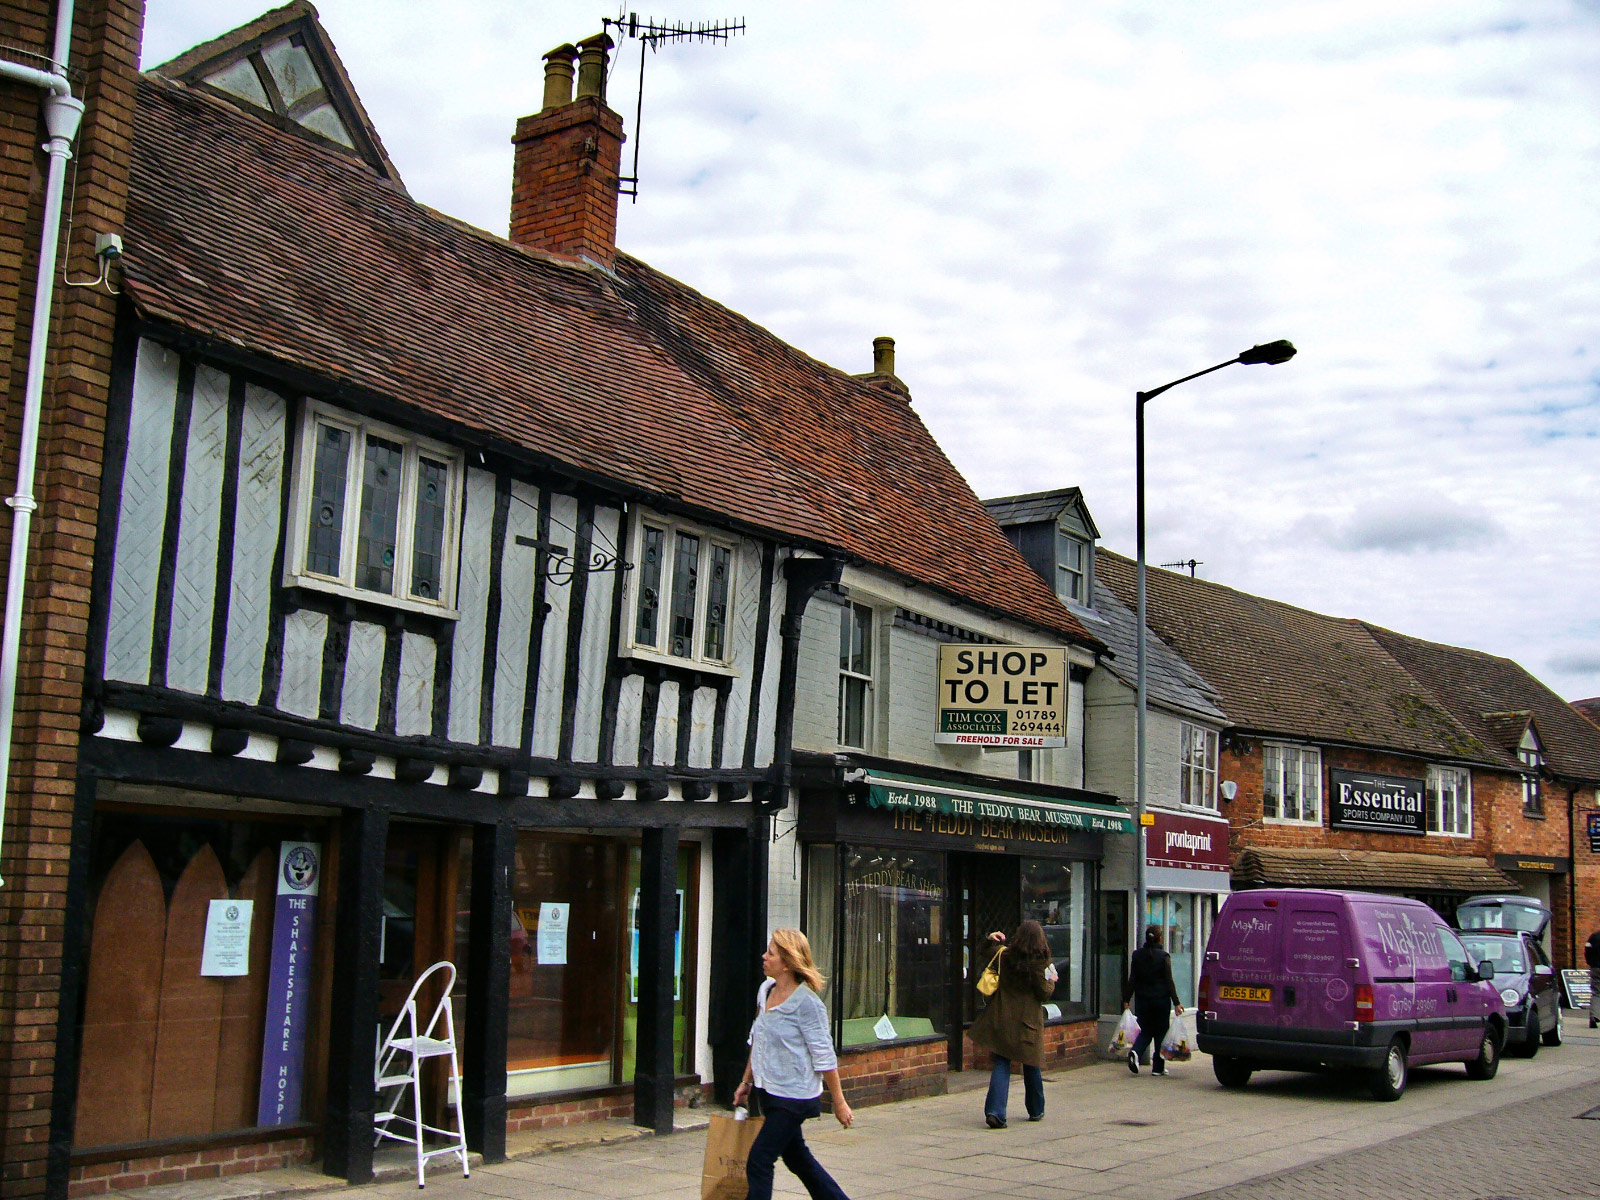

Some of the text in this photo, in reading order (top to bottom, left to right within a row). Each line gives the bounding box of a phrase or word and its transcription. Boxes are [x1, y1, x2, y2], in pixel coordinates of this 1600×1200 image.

[957, 650, 1048, 676] SHOP
[945, 679, 1059, 705] TO LET
[947, 712, 1002, 724] TIM COX
[1016, 710, 1057, 720] 01789
[947, 723, 1002, 732] ASSOCIATES
[1012, 721, 1060, 732] 269444
[956, 735, 1043, 745] FREEHOLD FOR SALE
[1374, 779, 1386, 789] THE
[1339, 782, 1423, 813] Essential
[888, 791, 912, 806] Estd.
[914, 794, 937, 808] 1988
[951, 799, 974, 814] THE
[977, 802, 1014, 818] TEDDY
[1017, 807, 1041, 821] BEAR
[1045, 810, 1084, 826] MUSEUM
[1343, 808, 1416, 824] SPORTS COMPANY LTD
[981, 816, 1013, 840] BEAR
[1018, 821, 1069, 844] MUSEUM
[1165, 829, 1212, 856] prontaprint
[863, 869, 894, 890] TEDDY
[289, 898, 307, 909] THE
[282, 915, 299, 1052] SHAKESPEARE
[1223, 988, 1268, 999] BG55 BLK
